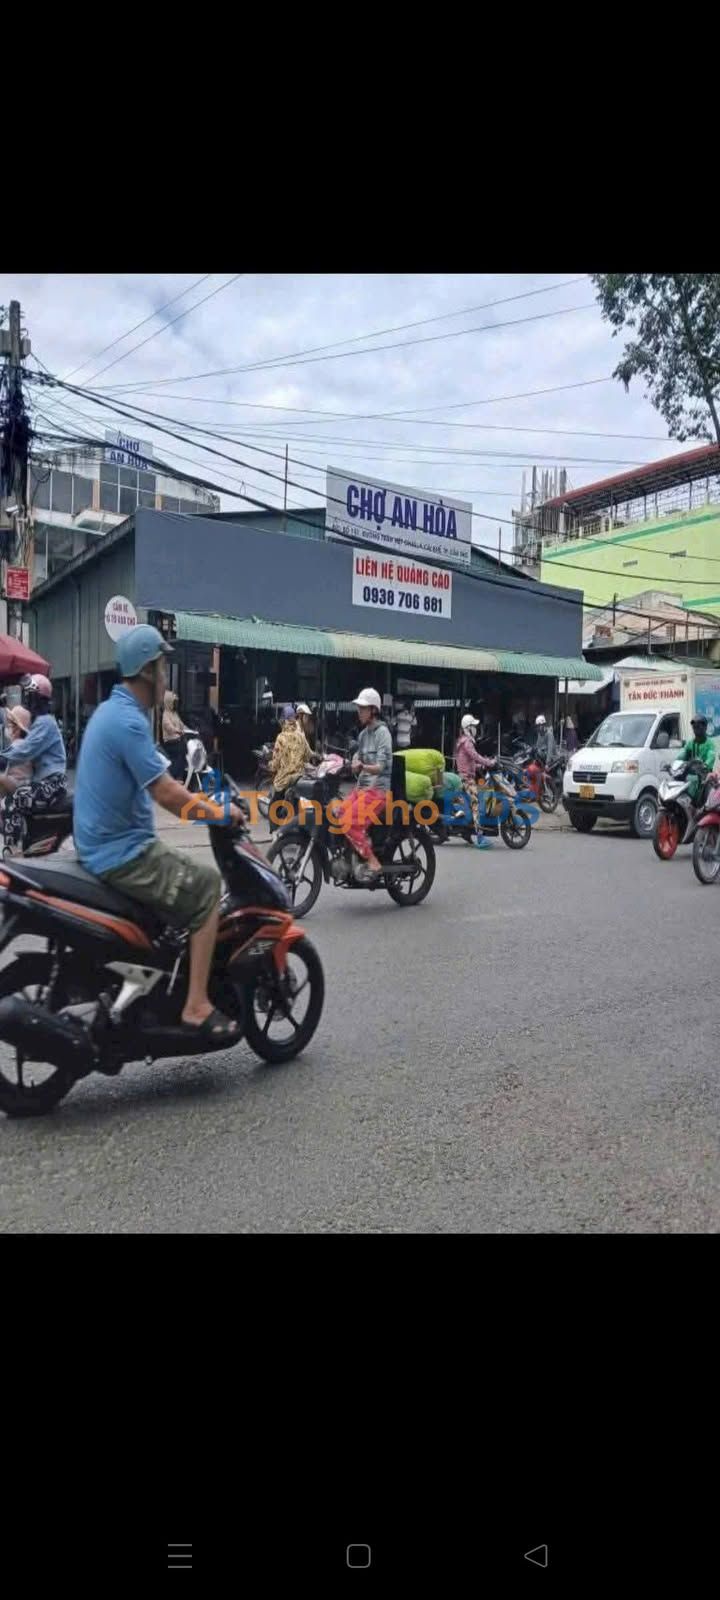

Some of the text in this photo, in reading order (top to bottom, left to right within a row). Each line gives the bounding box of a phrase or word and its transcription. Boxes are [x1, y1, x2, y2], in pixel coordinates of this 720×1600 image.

[110, 450, 125, 464] AN
[346, 485, 457, 539] CHỢ AN HÒA
[355, 556, 450, 590] LIÊN HỆ QUẢNG CÁO
[363, 585, 443, 614] 0938 706 881
[660, 688, 684, 699] THÀNH
